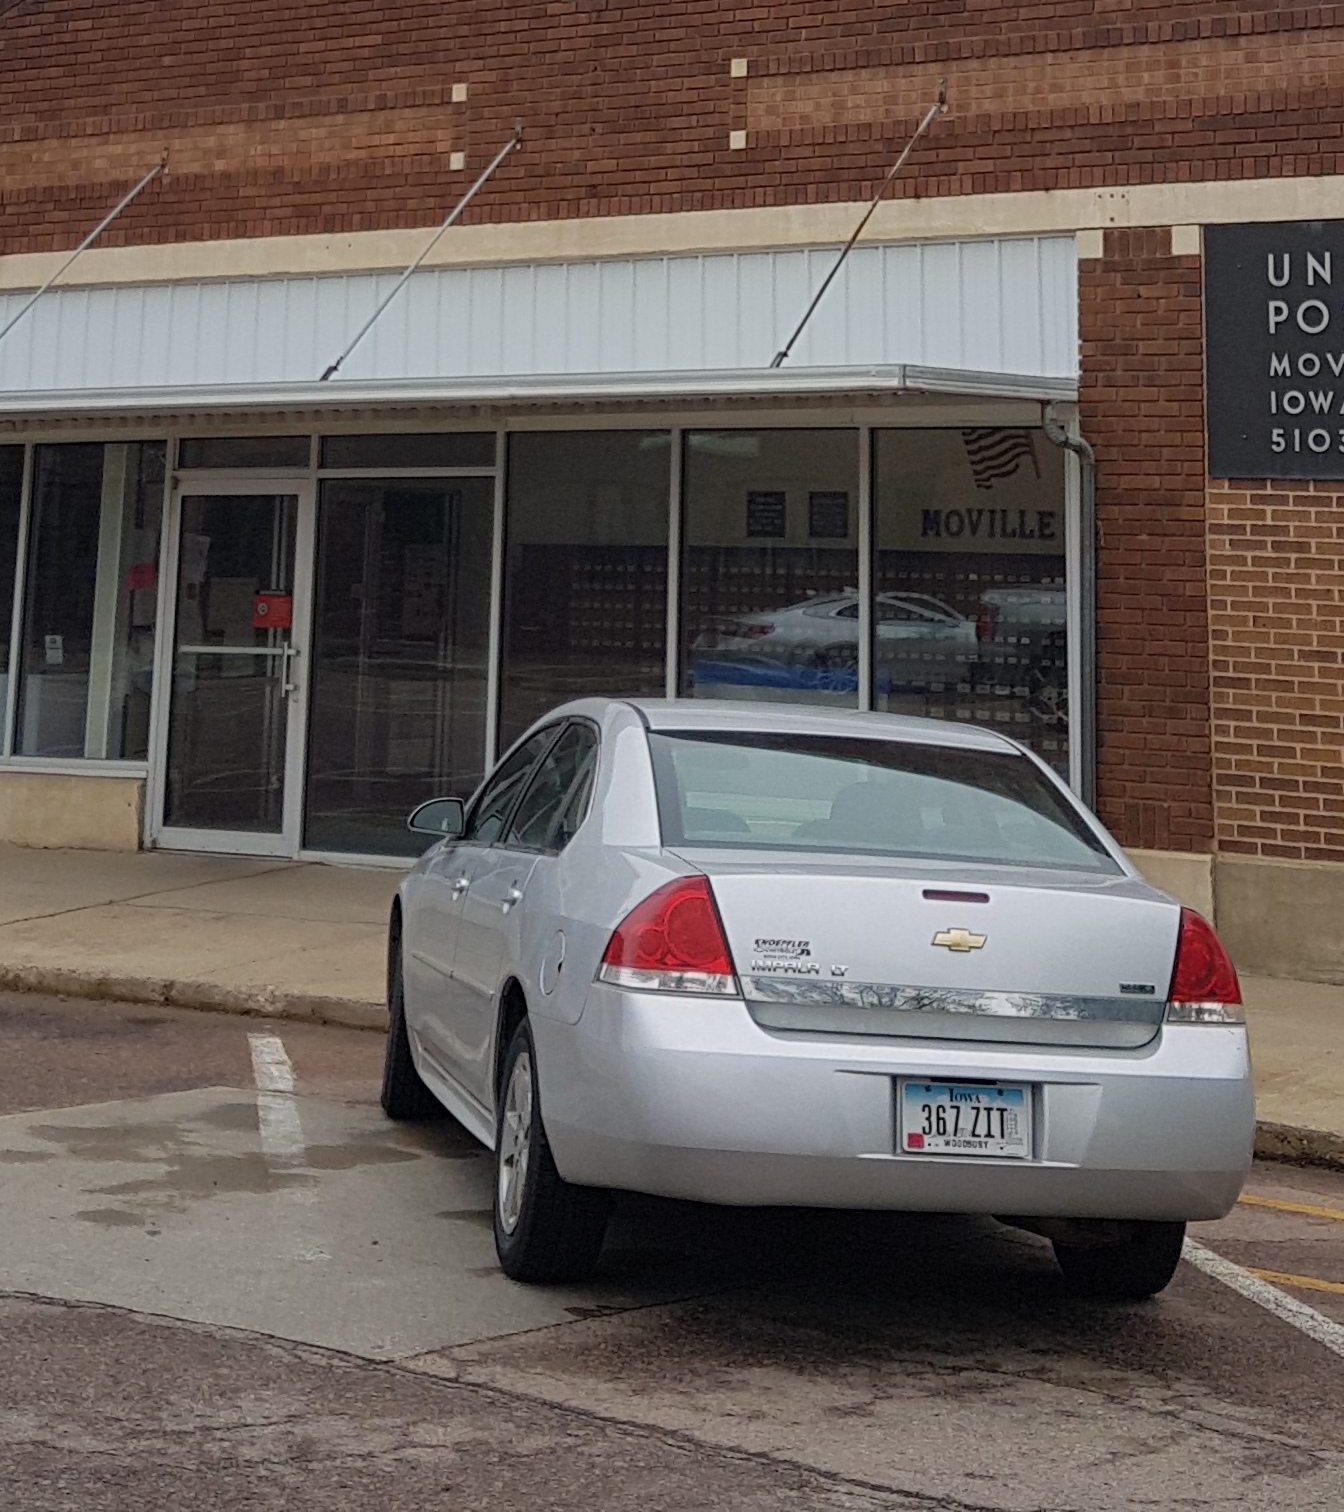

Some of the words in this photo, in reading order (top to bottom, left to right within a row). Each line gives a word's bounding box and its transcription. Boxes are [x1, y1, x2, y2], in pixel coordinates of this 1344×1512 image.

[921, 508, 1056, 539] MOVILLE
[751, 960, 820, 975] IMPALA
[831, 964, 849, 977] LT
[921, 1104, 961, 1137] 367
[970, 1106, 1008, 1139] ZIT
